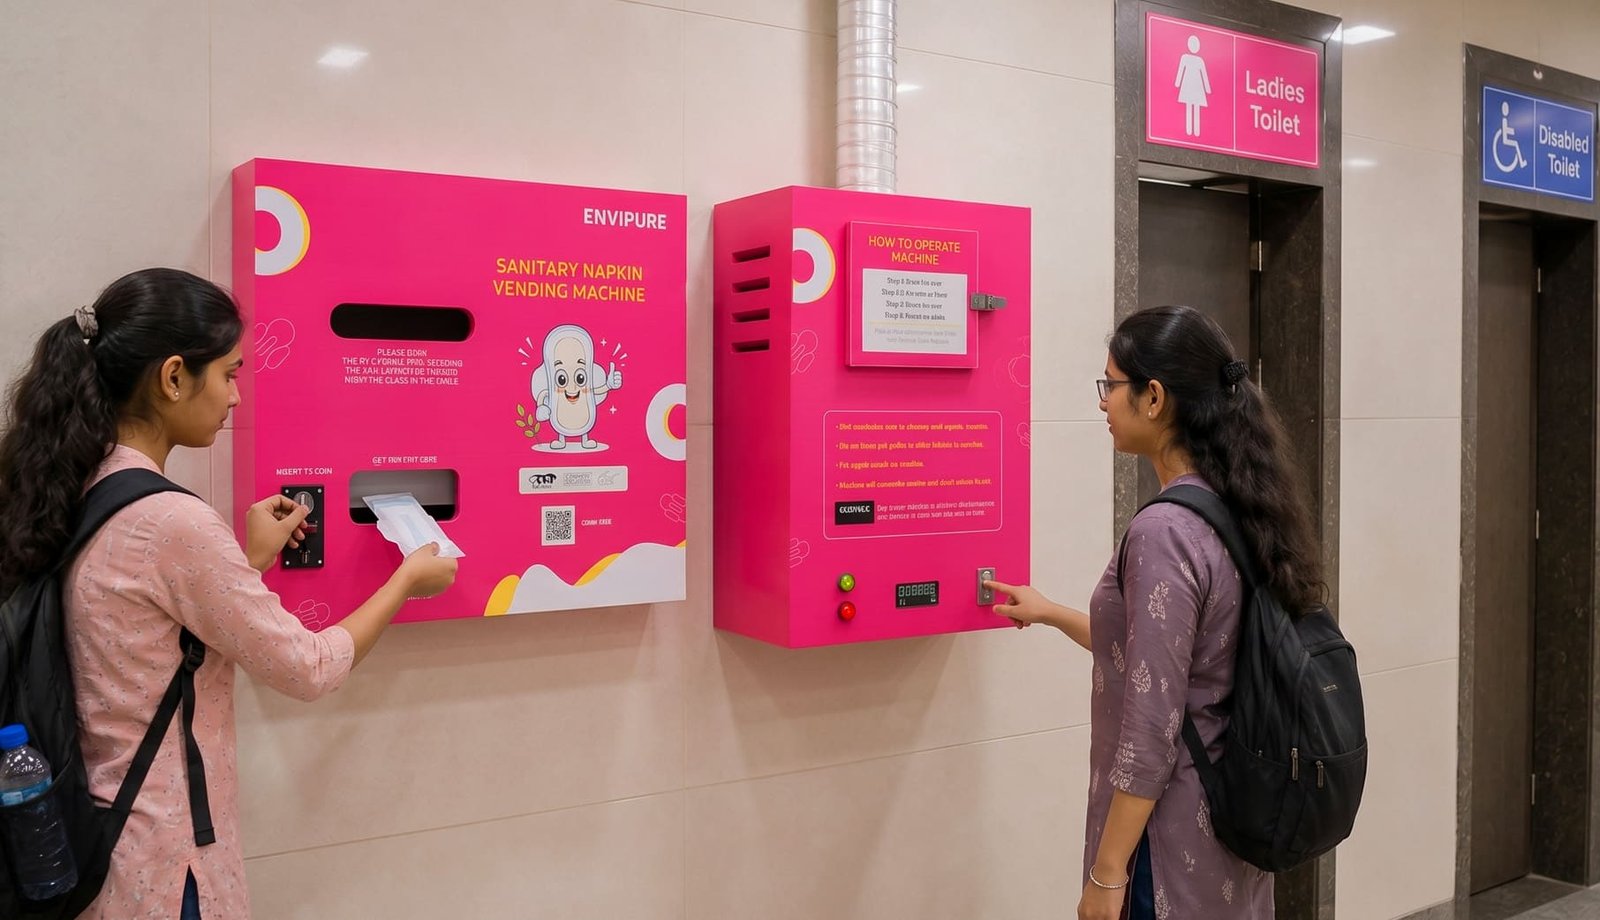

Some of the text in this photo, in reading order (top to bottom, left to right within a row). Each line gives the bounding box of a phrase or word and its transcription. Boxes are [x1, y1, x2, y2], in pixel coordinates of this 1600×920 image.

[1246, 70, 1305, 104] Ladies
[1250, 104, 1300, 136] Toilet
[1539, 124, 1589, 154] Disabled
[1548, 153, 1580, 178] Toilet
[583, 207, 667, 230] ENVIPURE
[868, 235, 961, 253] HOW TO OPERATE
[891, 251, 940, 265] MACHINE
[496, 257, 643, 281] SANITARY NAPKIN
[493, 279, 646, 303] VENDING MACHINE
[342, 357, 358, 365] THE
[377, 348, 406, 357] PLEASE
[345, 366, 361, 374] THE
[369, 376, 384, 384] THE
[420, 377, 435, 385] THE
[372, 456, 386, 464] GET
[314, 467, 333, 475] COIN
